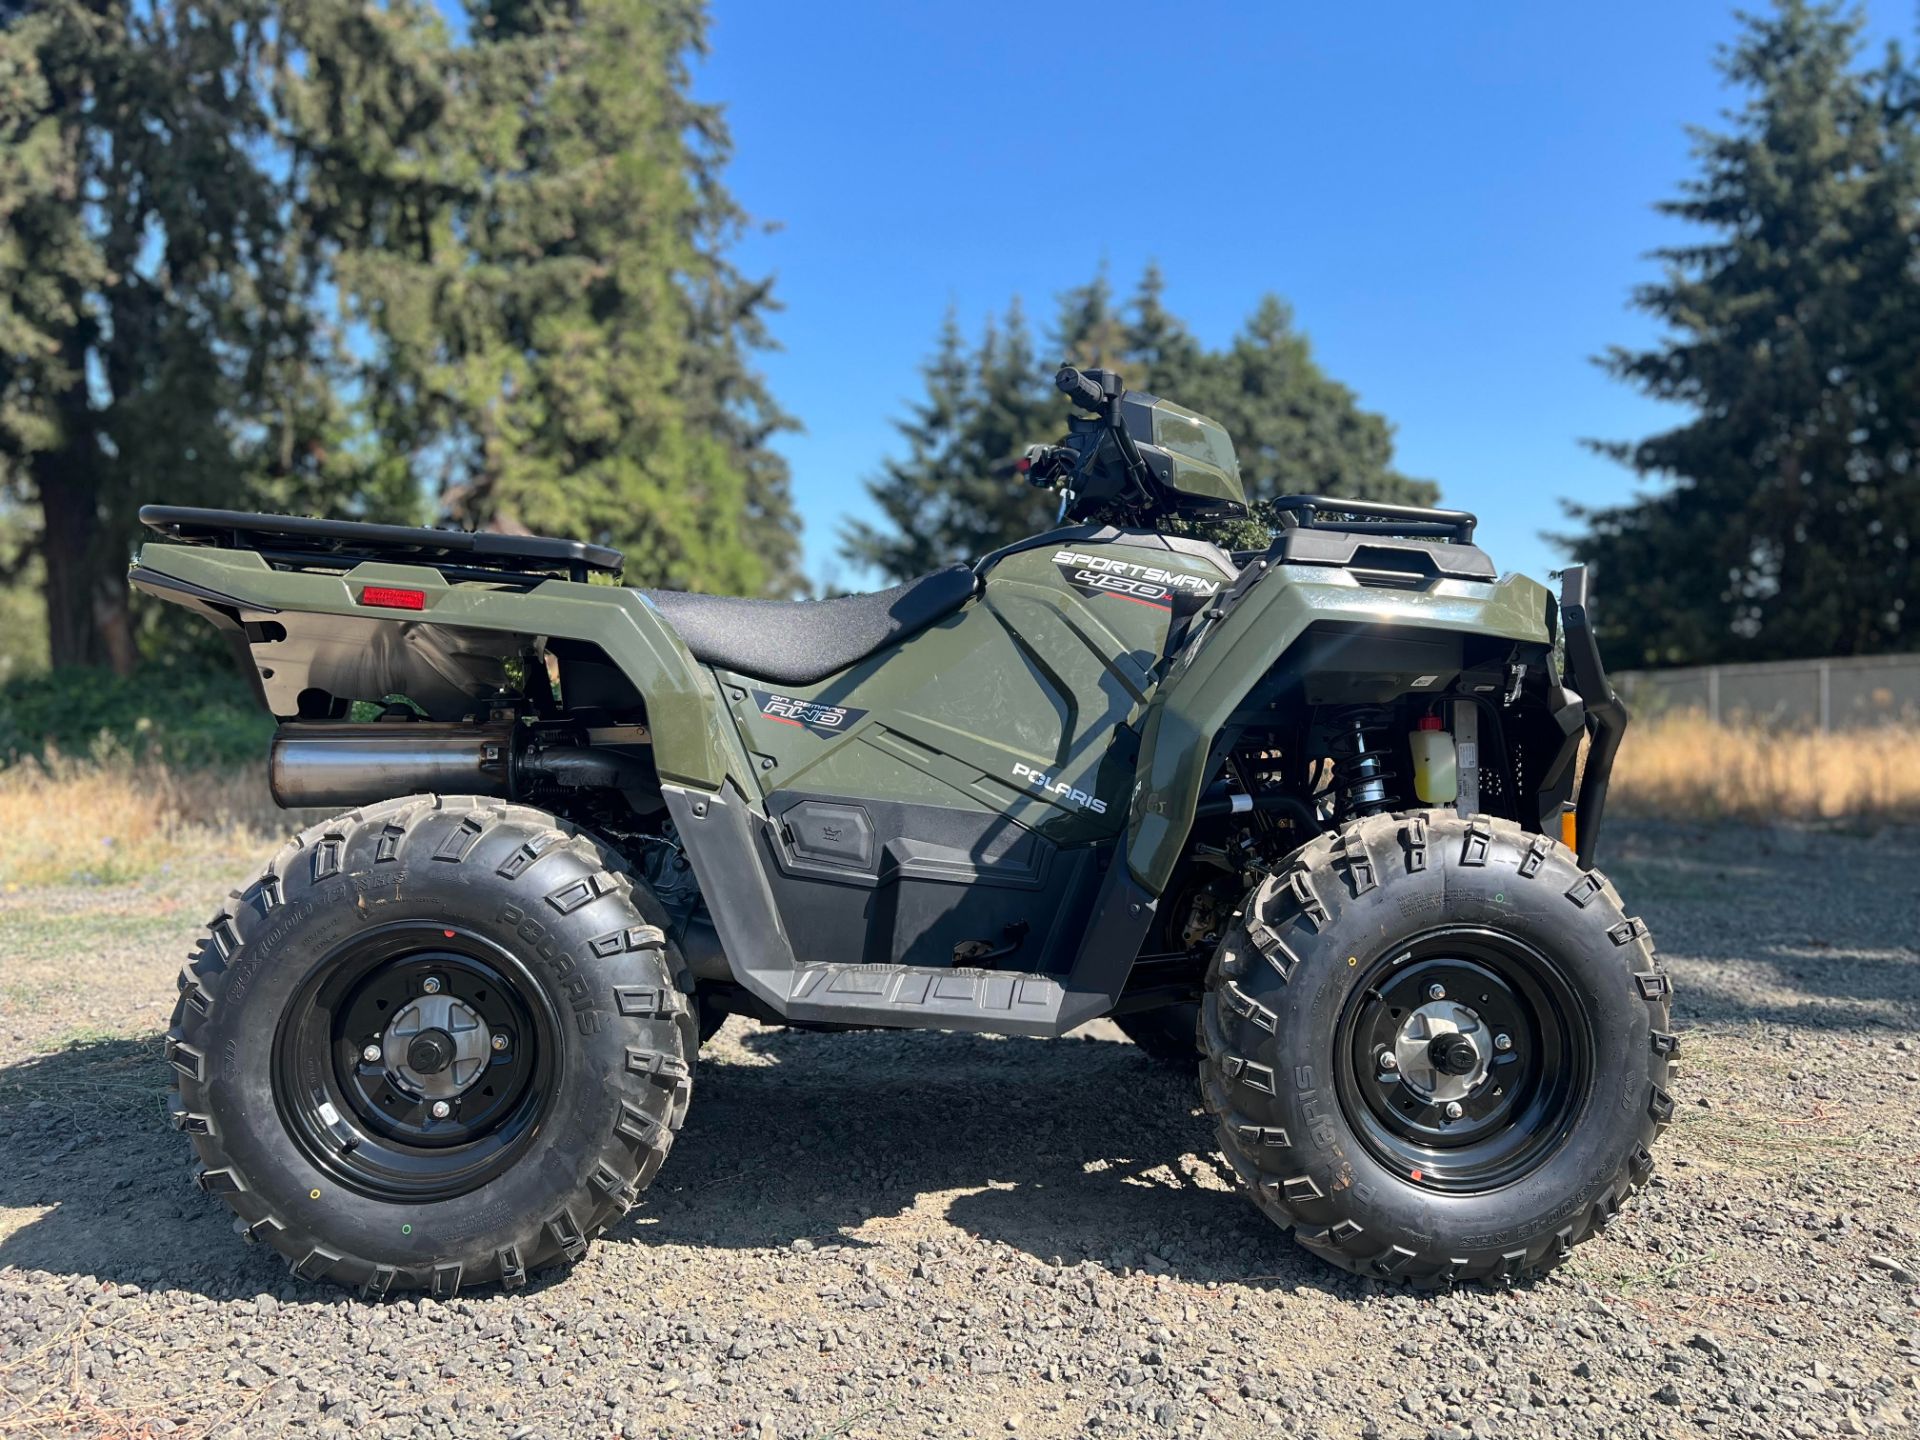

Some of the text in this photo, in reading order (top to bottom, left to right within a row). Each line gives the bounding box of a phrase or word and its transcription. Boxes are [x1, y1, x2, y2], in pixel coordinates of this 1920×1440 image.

[1051, 550, 1222, 594] SPORTSMAN
[1074, 570, 1168, 599] 450
[763, 701, 843, 726] AWD
[770, 695, 847, 714] ON DEMAND
[1012, 762, 1108, 814] POLARIS
[496, 901, 601, 1036] POLARIS
